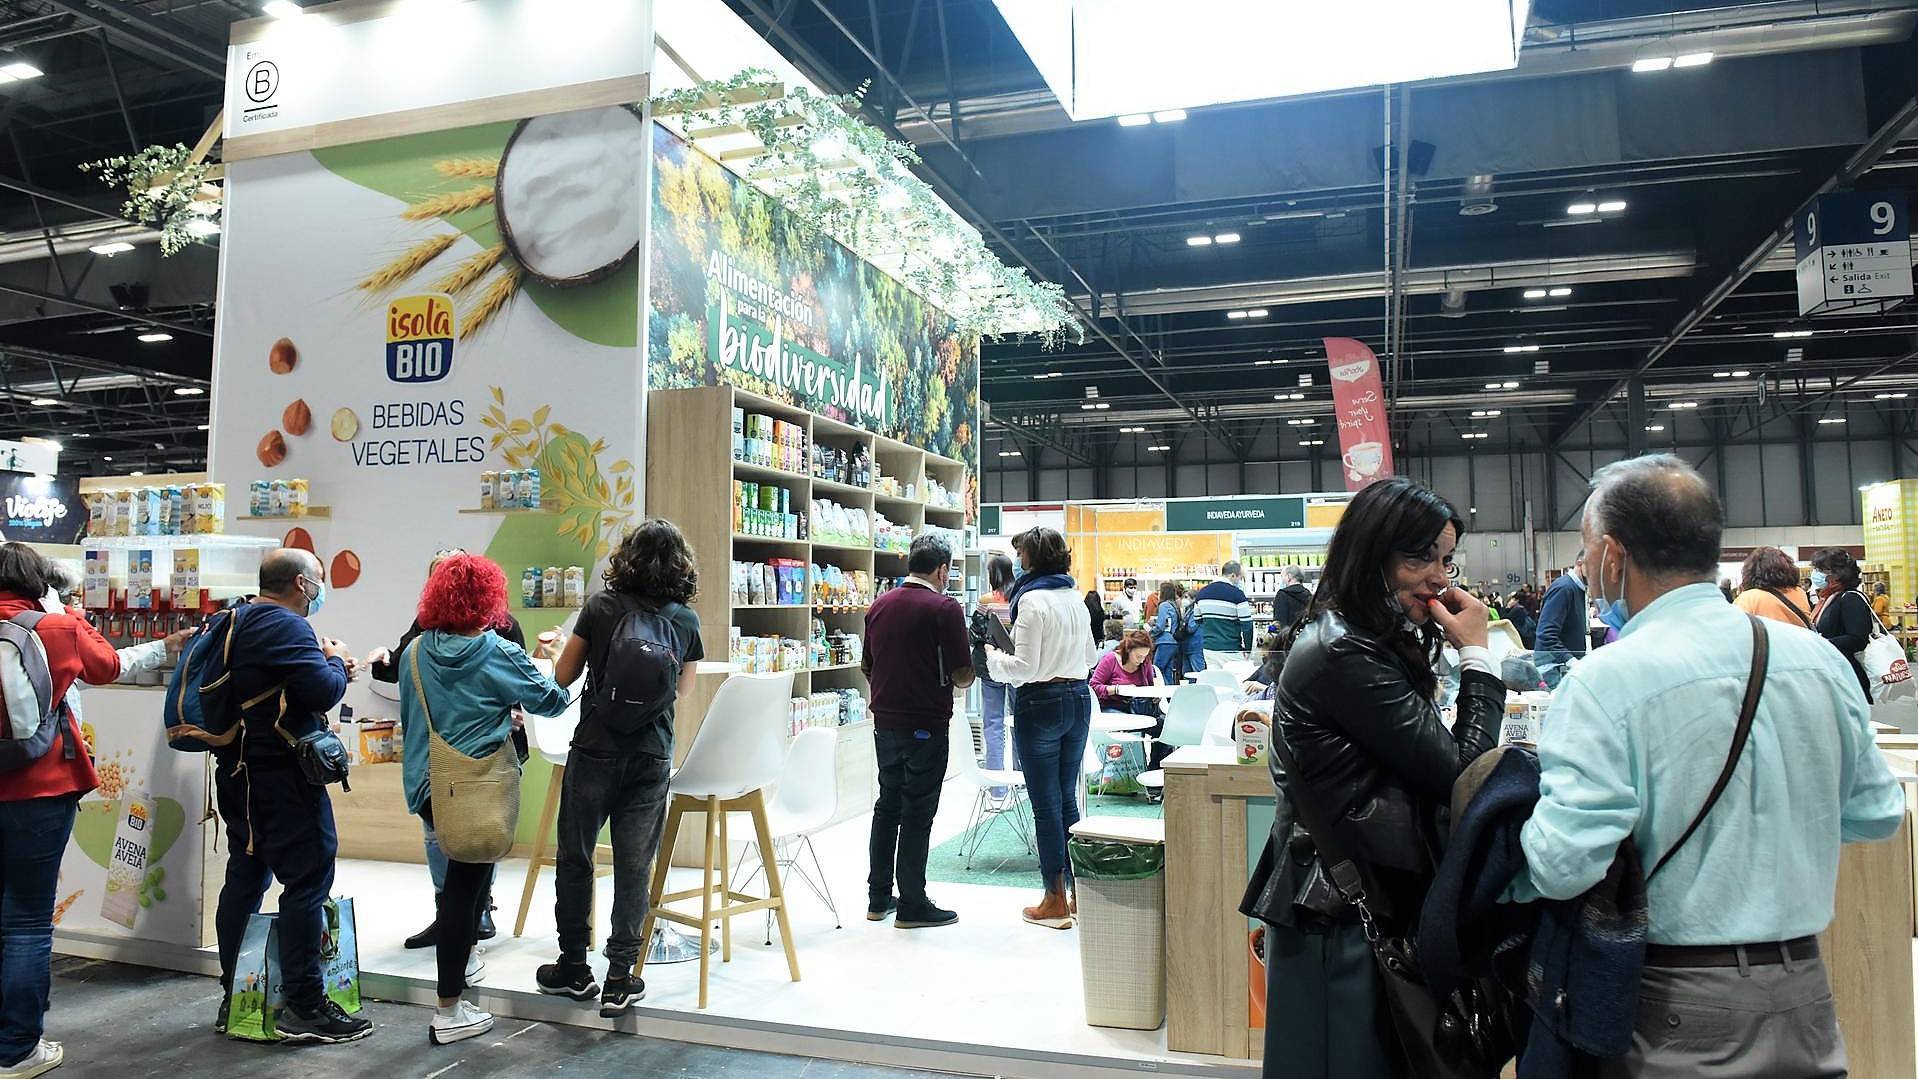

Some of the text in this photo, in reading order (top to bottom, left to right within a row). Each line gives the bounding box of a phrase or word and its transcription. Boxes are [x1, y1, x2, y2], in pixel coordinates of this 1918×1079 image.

[255, 69, 271, 94] B
[1807, 211, 1817, 246] 9
[1870, 201, 1896, 235] 9
[707, 249, 814, 327] Alimentación
[1842, 272, 1891, 282] Salida Exit
[390, 298, 450, 338] isola
[737, 299, 757, 318] para
[396, 341, 443, 379] BIO
[718, 287, 887, 429] biodiversidad
[373, 400, 464, 429] BEBIDAS
[352, 436, 485, 467] VEGETALES
[1236, 509, 1265, 519] AYURVEDA
[1872, 505, 1893, 523] ANETO
[1118, 536, 1193, 552] INDIAVEDA
[1506, 572, 1521, 583] 9b
[1504, 724, 1529, 732] AVENA
[131, 816, 143, 828] BIO
[115, 837, 146, 859] AVENA
[115, 849, 142, 869] AVEIA
